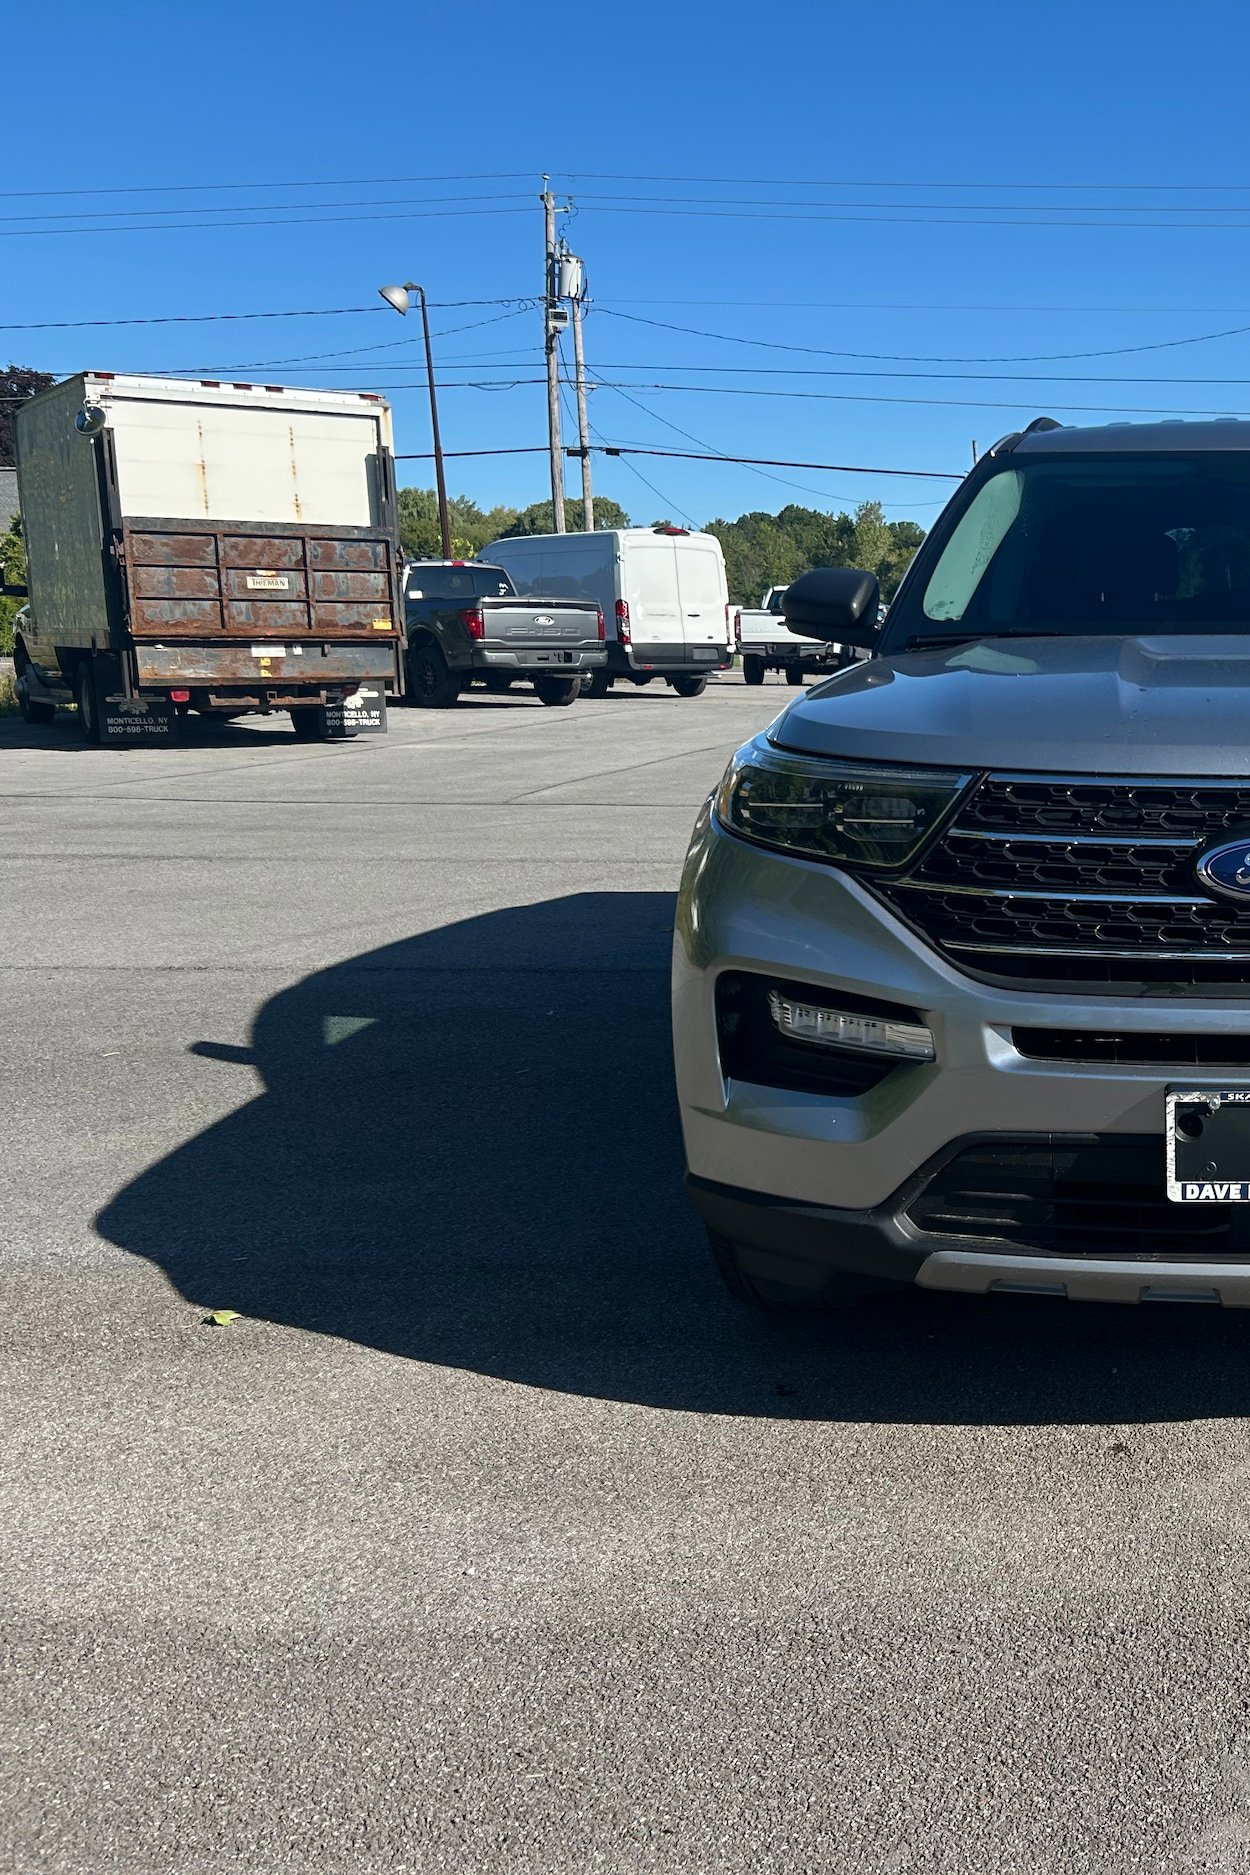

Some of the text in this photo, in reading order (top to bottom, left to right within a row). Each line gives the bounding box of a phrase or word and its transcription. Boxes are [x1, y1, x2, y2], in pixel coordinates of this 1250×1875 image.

[506, 626, 581, 636] F-150
[370, 710, 381, 718] NY
[108, 725, 169, 733] 800-598-TRUCK
[1185, 1184, 1241, 1200] DAVE
